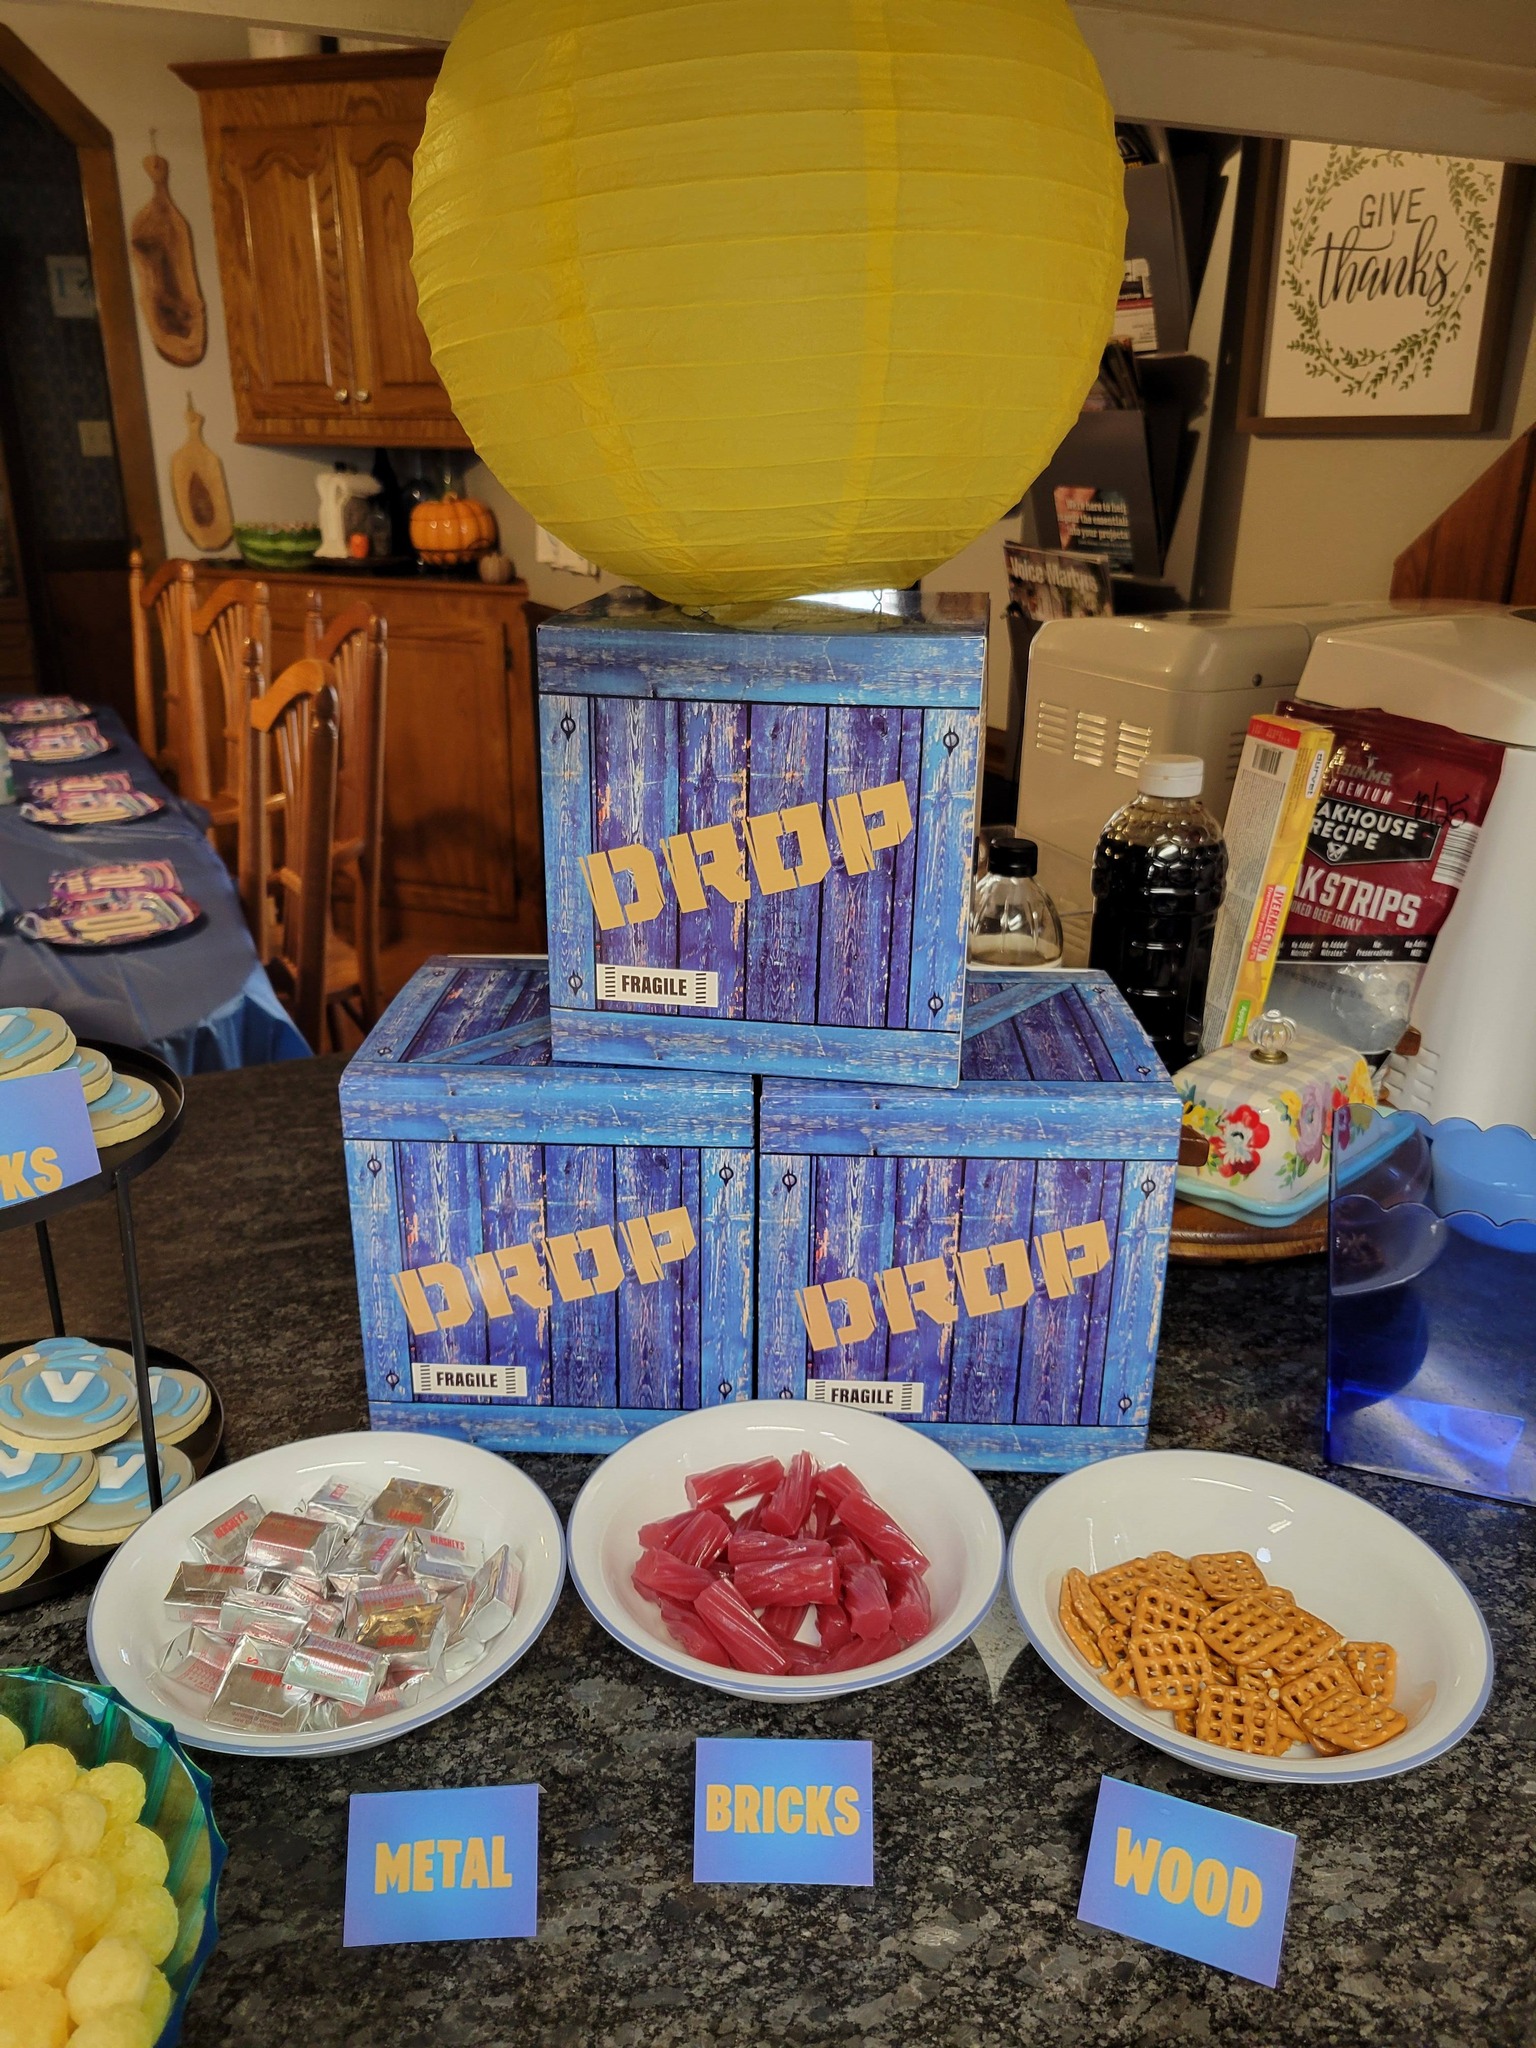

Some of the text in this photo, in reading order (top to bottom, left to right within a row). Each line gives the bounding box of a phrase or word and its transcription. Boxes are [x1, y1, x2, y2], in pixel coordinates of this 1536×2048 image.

[1359, 187, 1426, 229] GIVE
[1311, 215, 1458, 309] thanks
[1307, 753, 1323, 795] durvet
[1328, 778, 1393, 805] PREMIUM
[1310, 818, 1380, 850] RECIPE
[1316, 800, 1419, 841] AKHOUSE
[578, 780, 914, 931] DROP
[1312, 906, 1334, 925] BEEF
[1333, 912, 1363, 932] JERKY
[1319, 872, 1423, 929] STRIPS
[1258, 891, 1285, 956] IVERMECTIN
[621, 974, 688, 997] FRAGILE
[0, 1146, 63, 1200] KS
[390, 1206, 697, 1336] DROP
[795, 1219, 1111, 1351] DROP
[436, 1371, 498, 1389] FRAGILE
[831, 1387, 894, 1405] FRAGILE
[430, 1535, 466, 1551] HERSHEY'S
[204, 1563, 245, 1576] HERSHEY'S
[705, 1783, 861, 1838] BRICKS
[373, 1834, 514, 1895] METAL
[1113, 1826, 1264, 1929] WOOD
